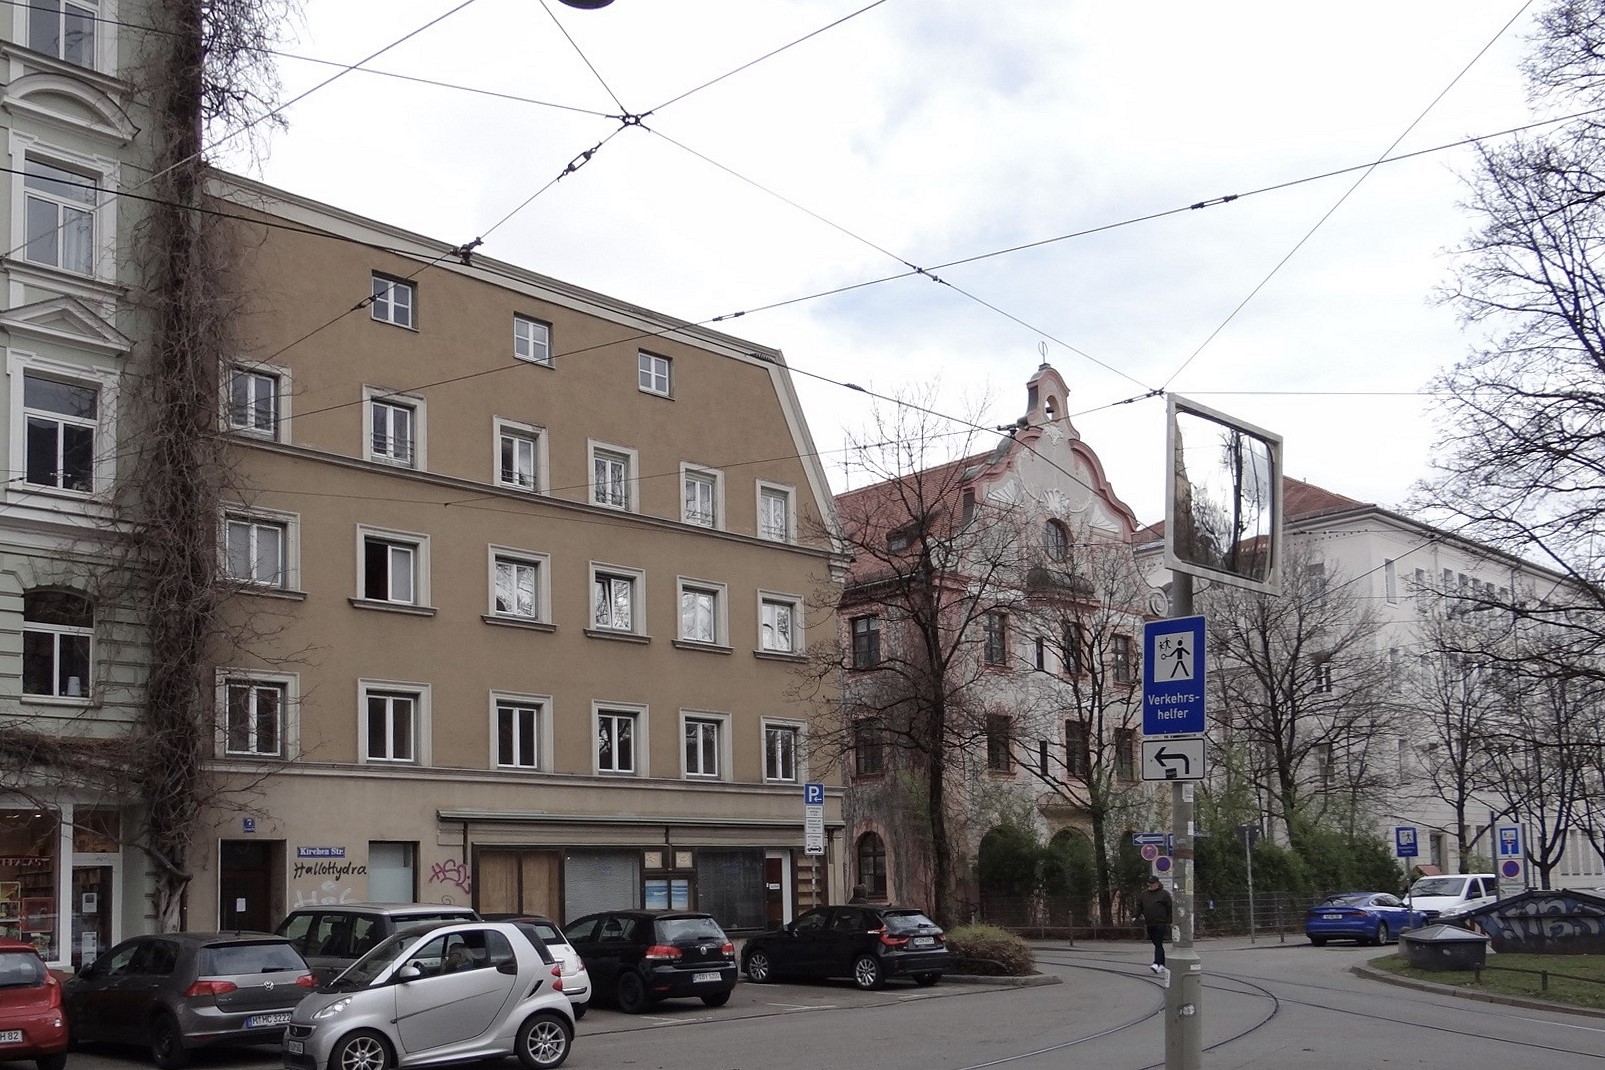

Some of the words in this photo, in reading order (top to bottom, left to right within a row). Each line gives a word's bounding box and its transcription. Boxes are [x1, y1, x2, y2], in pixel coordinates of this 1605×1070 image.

[1148, 693, 1200, 705] Verkehrs-
[1157, 708, 1189, 720] helfer
[808, 785, 820, 803] P
[299, 847, 330, 856] Kirchen
[331, 848, 345, 856] Str.
[7, 1031, 19, 1041] 82
